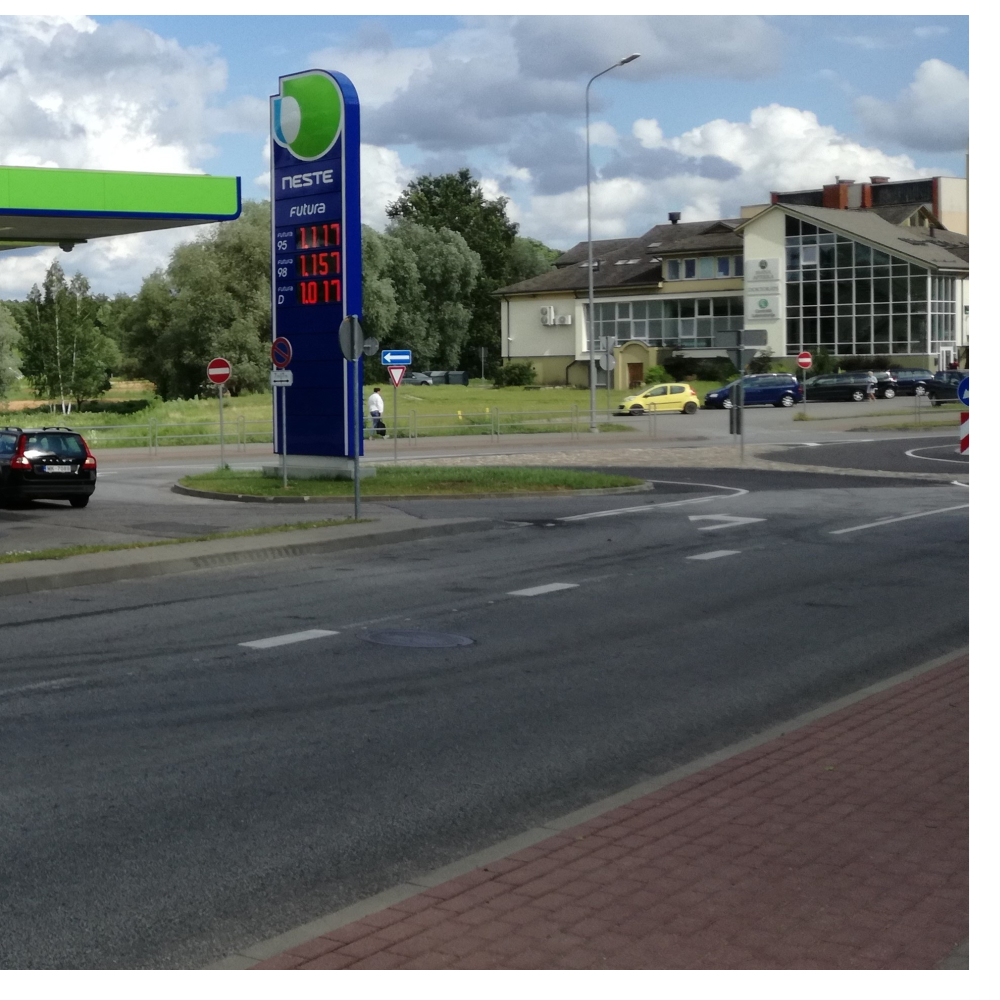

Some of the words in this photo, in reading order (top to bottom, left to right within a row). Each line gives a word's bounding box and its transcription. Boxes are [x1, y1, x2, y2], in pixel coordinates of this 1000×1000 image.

[281, 169, 334, 190] NESTE
[277, 240, 287, 250] 95
[277, 267, 287, 277] 98
[278, 294, 285, 305] D
